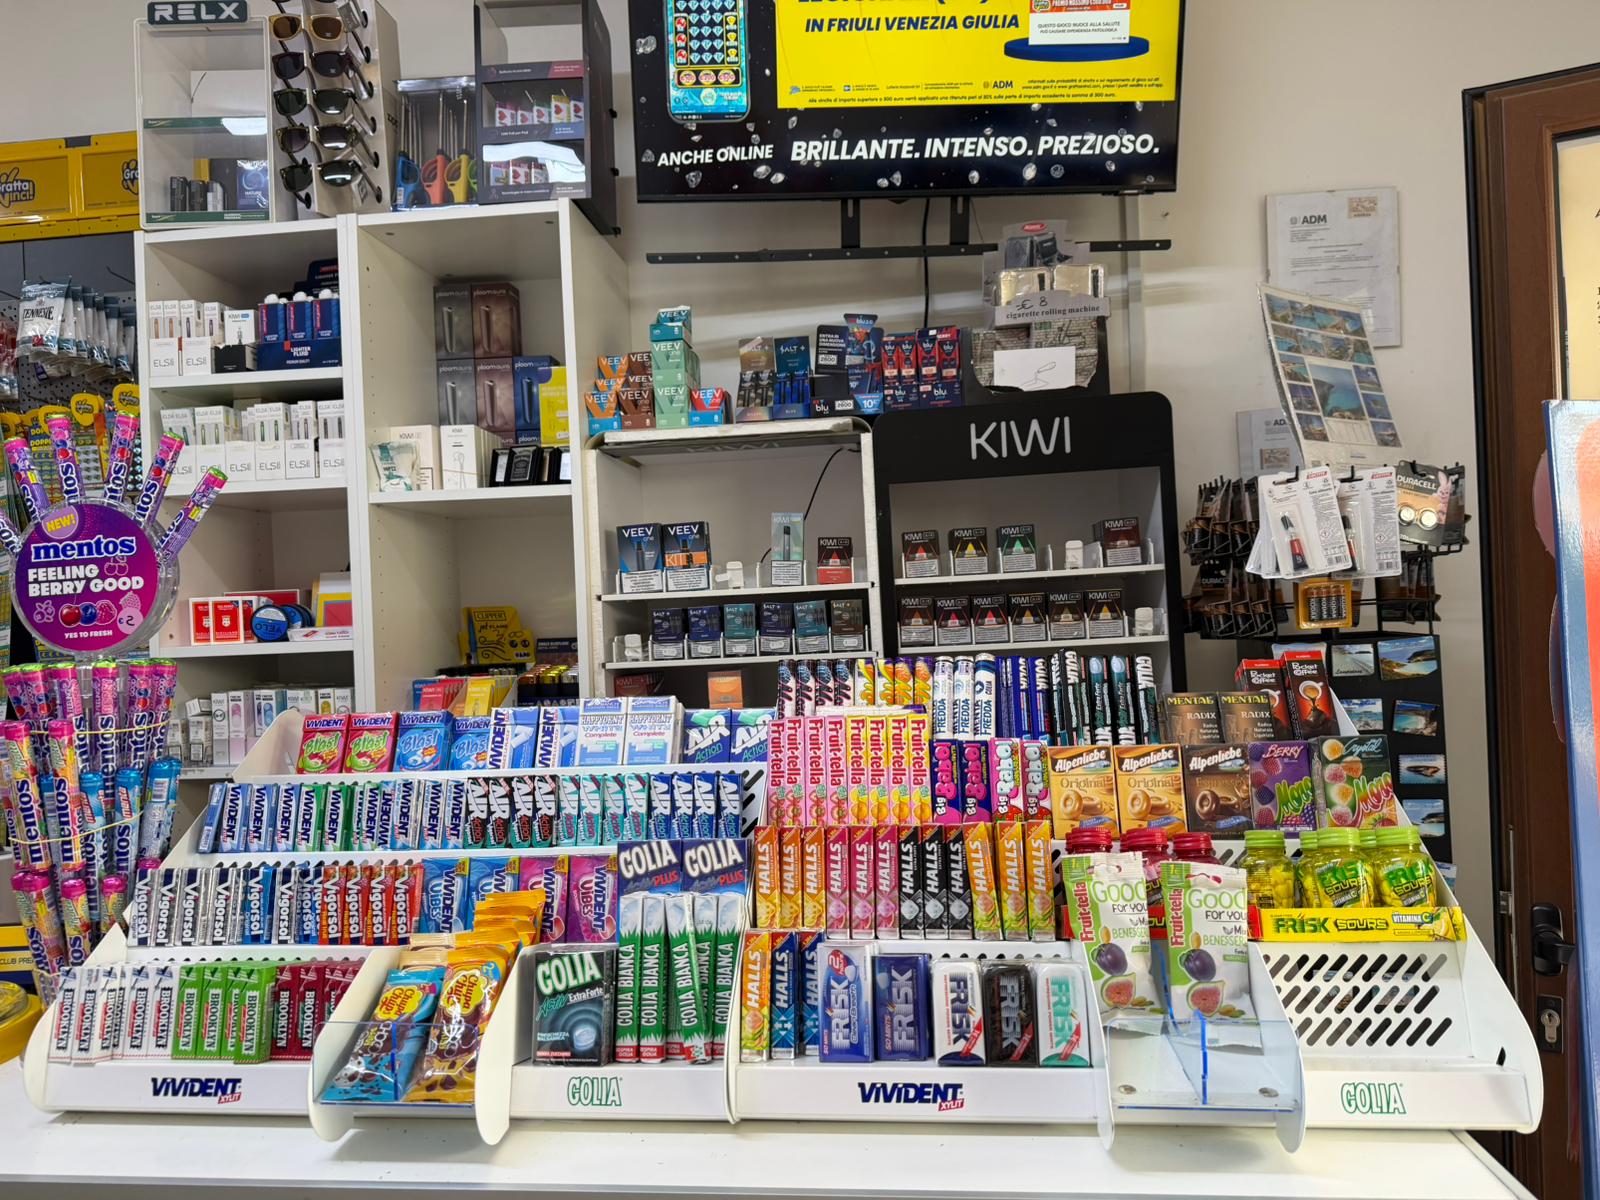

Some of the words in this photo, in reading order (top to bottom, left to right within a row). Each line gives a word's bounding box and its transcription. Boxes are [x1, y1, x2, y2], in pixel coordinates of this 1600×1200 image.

[154, 2, 240, 22] RELX
[805, 18, 826, 33] IN
[828, 17, 881, 32] FRIULI
[881, 15, 958, 31] VENEZIA
[962, 14, 1020, 30] GIULIA
[992, 80, 1014, 90] ADM
[657, 149, 713, 167] ANCHE
[716, 144, 774, 163] ONLINE
[790, 138, 921, 162] BRILLANTE.
[924, 135, 1033, 159] INTENSO.
[1037, 133, 1160, 157] PREZIOSO.
[1301, 214, 1327, 225] ADM
[1006, 307, 1040, 320] cigarette
[1041, 306, 1067, 318] rolling
[1068, 303, 1100, 315] machine
[653, 342, 681, 352] VEEV
[619, 390, 649, 401] VEEV
[657, 386, 685, 396] VEEV
[691, 387, 722, 399] VEEV
[895, 388, 906, 396] blu
[933, 387, 947, 396] blu
[815, 402, 829, 412] blu
[970, 416, 1071, 461] KIWI
[1397, 475, 1437, 490] DURACELL
[46, 512, 76, 533] NEW!
[622, 527, 653, 538] VEEV
[667, 524, 699, 536] VEEV
[1105, 519, 1124, 528] KIWI
[32, 535, 137, 562] mentos
[904, 533, 923, 542] KIWI
[28, 563, 100, 582] FEELING
[28, 577, 85, 598] BERRY
[90, 575, 145, 593] GOOD
[1050, 592, 1068, 602] KIWI
[1089, 591, 1106, 600] KIWI
[901, 597, 919, 606] KIWI
[937, 599, 955, 608] KIWI
[974, 597, 991, 606] KIWI
[1011, 596, 1029, 605] KIWI
[64, 631, 78, 640] YES
[79, 630, 88, 639] TO
[89, 628, 113, 638] FRESH
[1250, 670, 1276, 680] Pocket
[1292, 662, 1318, 672] Pocket
[1293, 669, 1318, 678] Coffee
[1251, 677, 1277, 685] Coffee
[1167, 695, 1214, 705] MENTAL
[1221, 694, 1268, 704] MENTAL
[579, 714, 624, 726] HAPPYDENT
[628, 713, 673, 725] HAPPYDENT
[935, 699, 946, 734] FREDDA
[959, 698, 970, 735] FREDDA
[980, 699, 992, 736] FREDDA
[1186, 711, 1216, 720] RADIX
[1241, 710, 1271, 719] RADIX
[400, 727, 439, 752] Blast
[632, 730, 666, 738] Complete
[695, 741, 724, 762] Action
[1055, 749, 1106, 773] Alpenliebe
[1121, 748, 1174, 773] Alpenliebe
[1189, 746, 1242, 773] Alpenliebe
[1262, 744, 1305, 759] BERRY
[1059, 776, 1106, 793] Original
[1127, 775, 1174, 793] Original
[16, 777, 44, 866] mentos
[54, 777, 76, 866] mentos
[655, 870, 679, 887] PLUS
[719, 869, 745, 886] PLUS
[759, 841, 775, 895] HALLS
[806, 841, 822, 895] HALLS
[830, 842, 845, 895] HALLS
[1324, 878, 1367, 897] SOURS
[1394, 875, 1432, 896] SOURS
[136, 874, 152, 939] Vigorsol
[157, 874, 178, 944] Vigorsol
[248, 873, 264, 936] Vigorsol
[279, 874, 296, 941] Vigorsol
[323, 870, 342, 939] Vigorsol
[1274, 915, 1331, 934] FRISK
[1334, 916, 1390, 931] SOURS
[1392, 912, 1421, 924] VITAMINA
[618, 944, 635, 988] BIANCA
[643, 943, 660, 988] BIANCA
[673, 942, 692, 989] BIANCA
[717, 943, 733, 987] BIANCA
[829, 954, 841, 969] 2
[537, 952, 602, 996] GOLIA
[746, 950, 761, 1009] HALLS
[774, 950, 790, 1009] HALLS
[379, 987, 405, 1015] Chups
[396, 988, 416, 1017] Chupa
[462, 974, 480, 1010] Chupa
[130, 987, 148, 1049] BROOKLYN
[617, 991, 633, 1027] GOLIA
[641, 991, 658, 1027] GOLIA
[681, 990, 698, 1028] GOLIA
[715, 990, 731, 1024] GOLIA
[893, 968, 914, 1052] FRISK
[949, 972, 972, 1045] FRISK
[1000, 975, 1019, 1047] FRISK
[1051, 976, 1073, 1047] FRISK
[56, 988, 74, 1050] BROOKLYN
[79, 989, 96, 1052] BROOKLYN
[179, 988, 197, 1051] BROOKLYN
[243, 990, 260, 1055] BROOKLYN
[276, 990, 290, 1049] BROOKLYN
[218, 1091, 242, 1104] XYLIT
[567, 1076, 623, 1106] GOLIA
[1340, 1082, 1407, 1114] GOLIA
[938, 1097, 965, 1112] XYLIT
